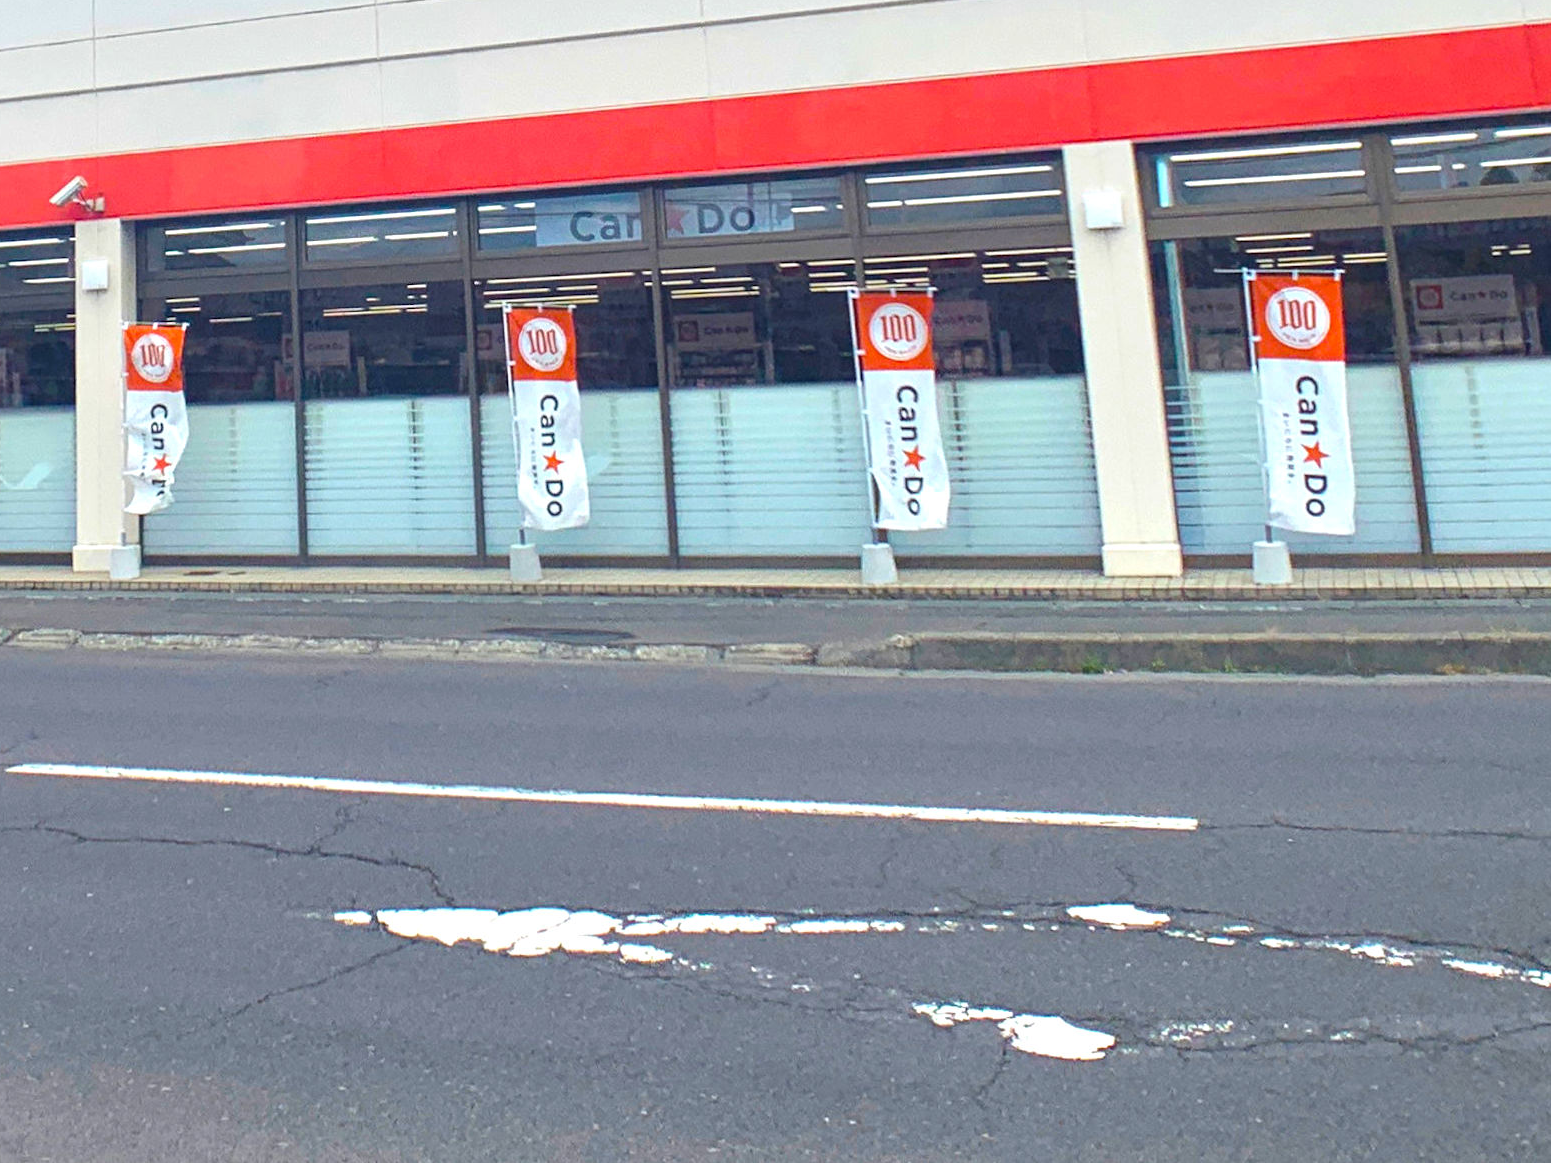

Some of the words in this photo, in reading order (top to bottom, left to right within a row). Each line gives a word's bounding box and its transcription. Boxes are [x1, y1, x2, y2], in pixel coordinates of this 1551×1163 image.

[698, 203, 756, 234] Do
[879, 313, 918, 343] 100
[1276, 299, 1317, 331] 100
[526, 328, 559, 356] 100
[540, 394, 559, 447] Can
[896, 385, 919, 442] Can
[1296, 375, 1319, 436] Can
[150, 403, 168, 451] Can
[545, 479, 565, 517] Do
[904, 476, 924, 517] Do
[1303, 473, 1328, 518] Do
